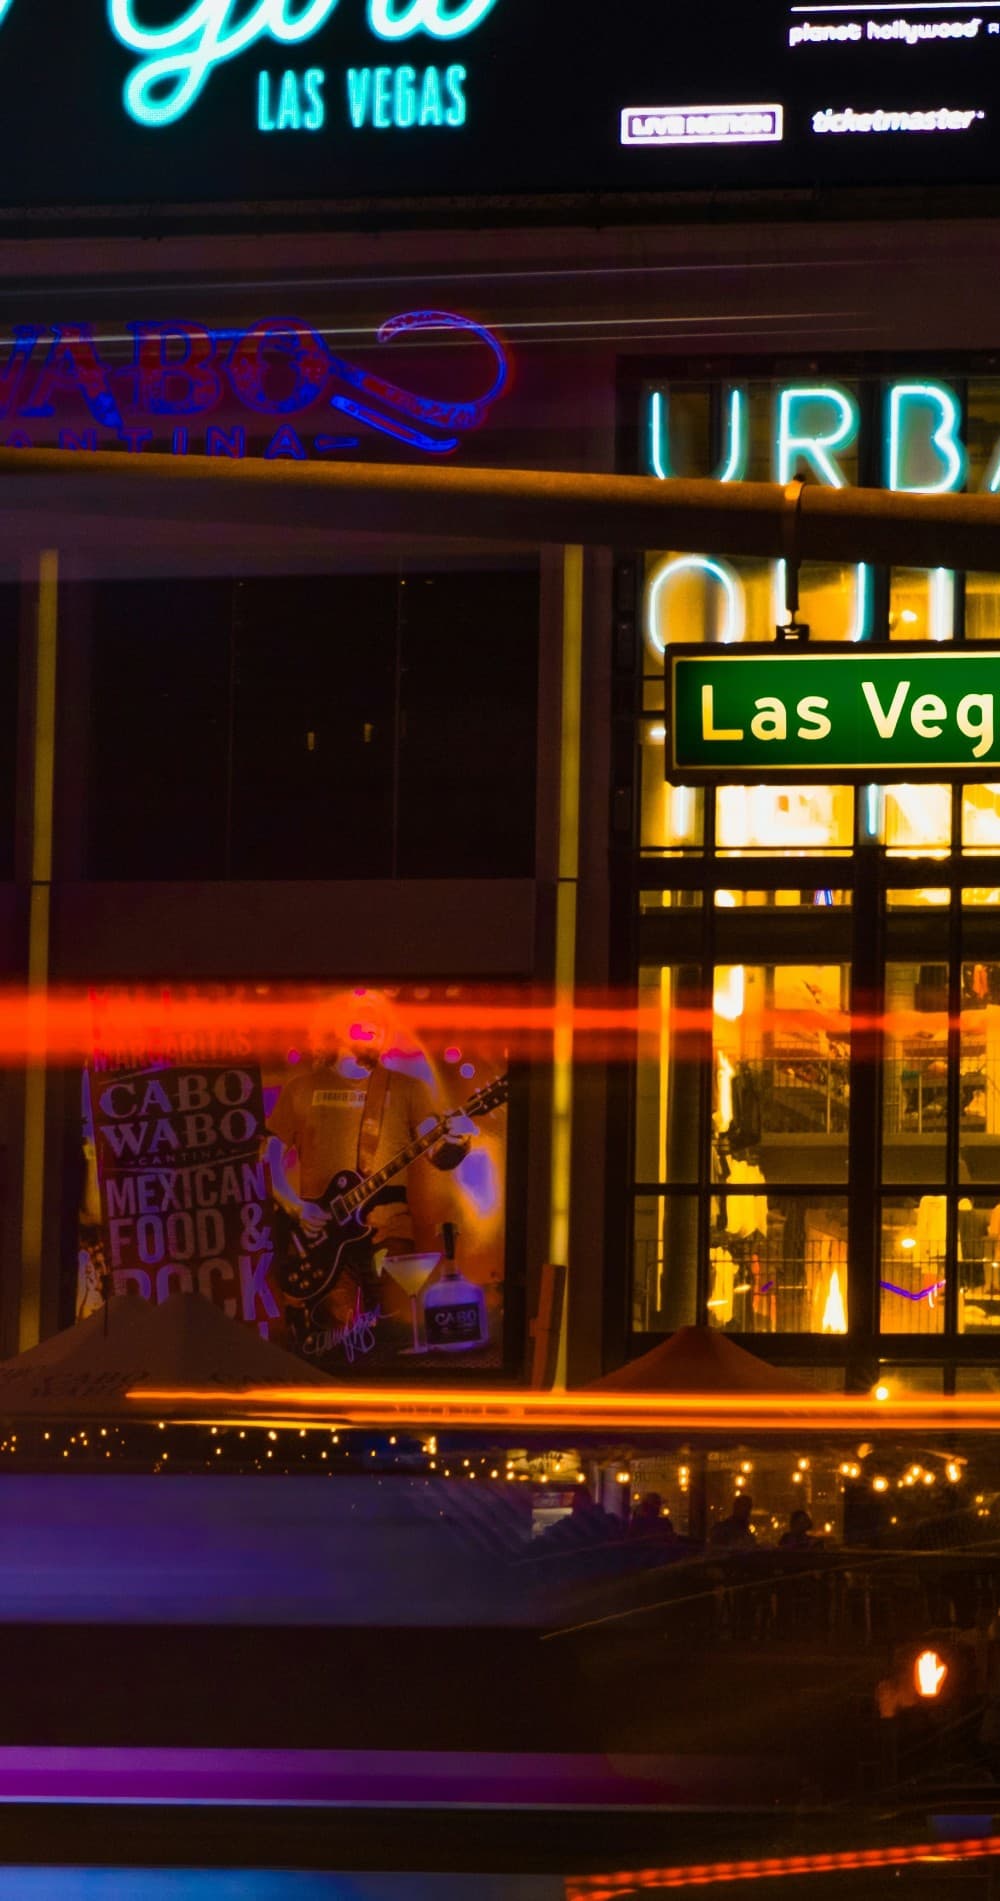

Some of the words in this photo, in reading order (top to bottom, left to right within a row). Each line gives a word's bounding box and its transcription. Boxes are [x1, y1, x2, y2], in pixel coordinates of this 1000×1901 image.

[788, 20, 862, 46] planet
[867, 18, 980, 44] hollywood
[257, 69, 326, 132] LAS
[346, 64, 467, 129] VEGAS
[631, 114, 685, 137] LIVE
[701, 683, 832, 742] Las
[99, 1069, 256, 1120] CABO
[98, 1108, 259, 1160] WABO
[106, 1161, 267, 1218] MEXICAN
[110, 1208, 227, 1267] FOOD
[239, 1202, 275, 1253] &
